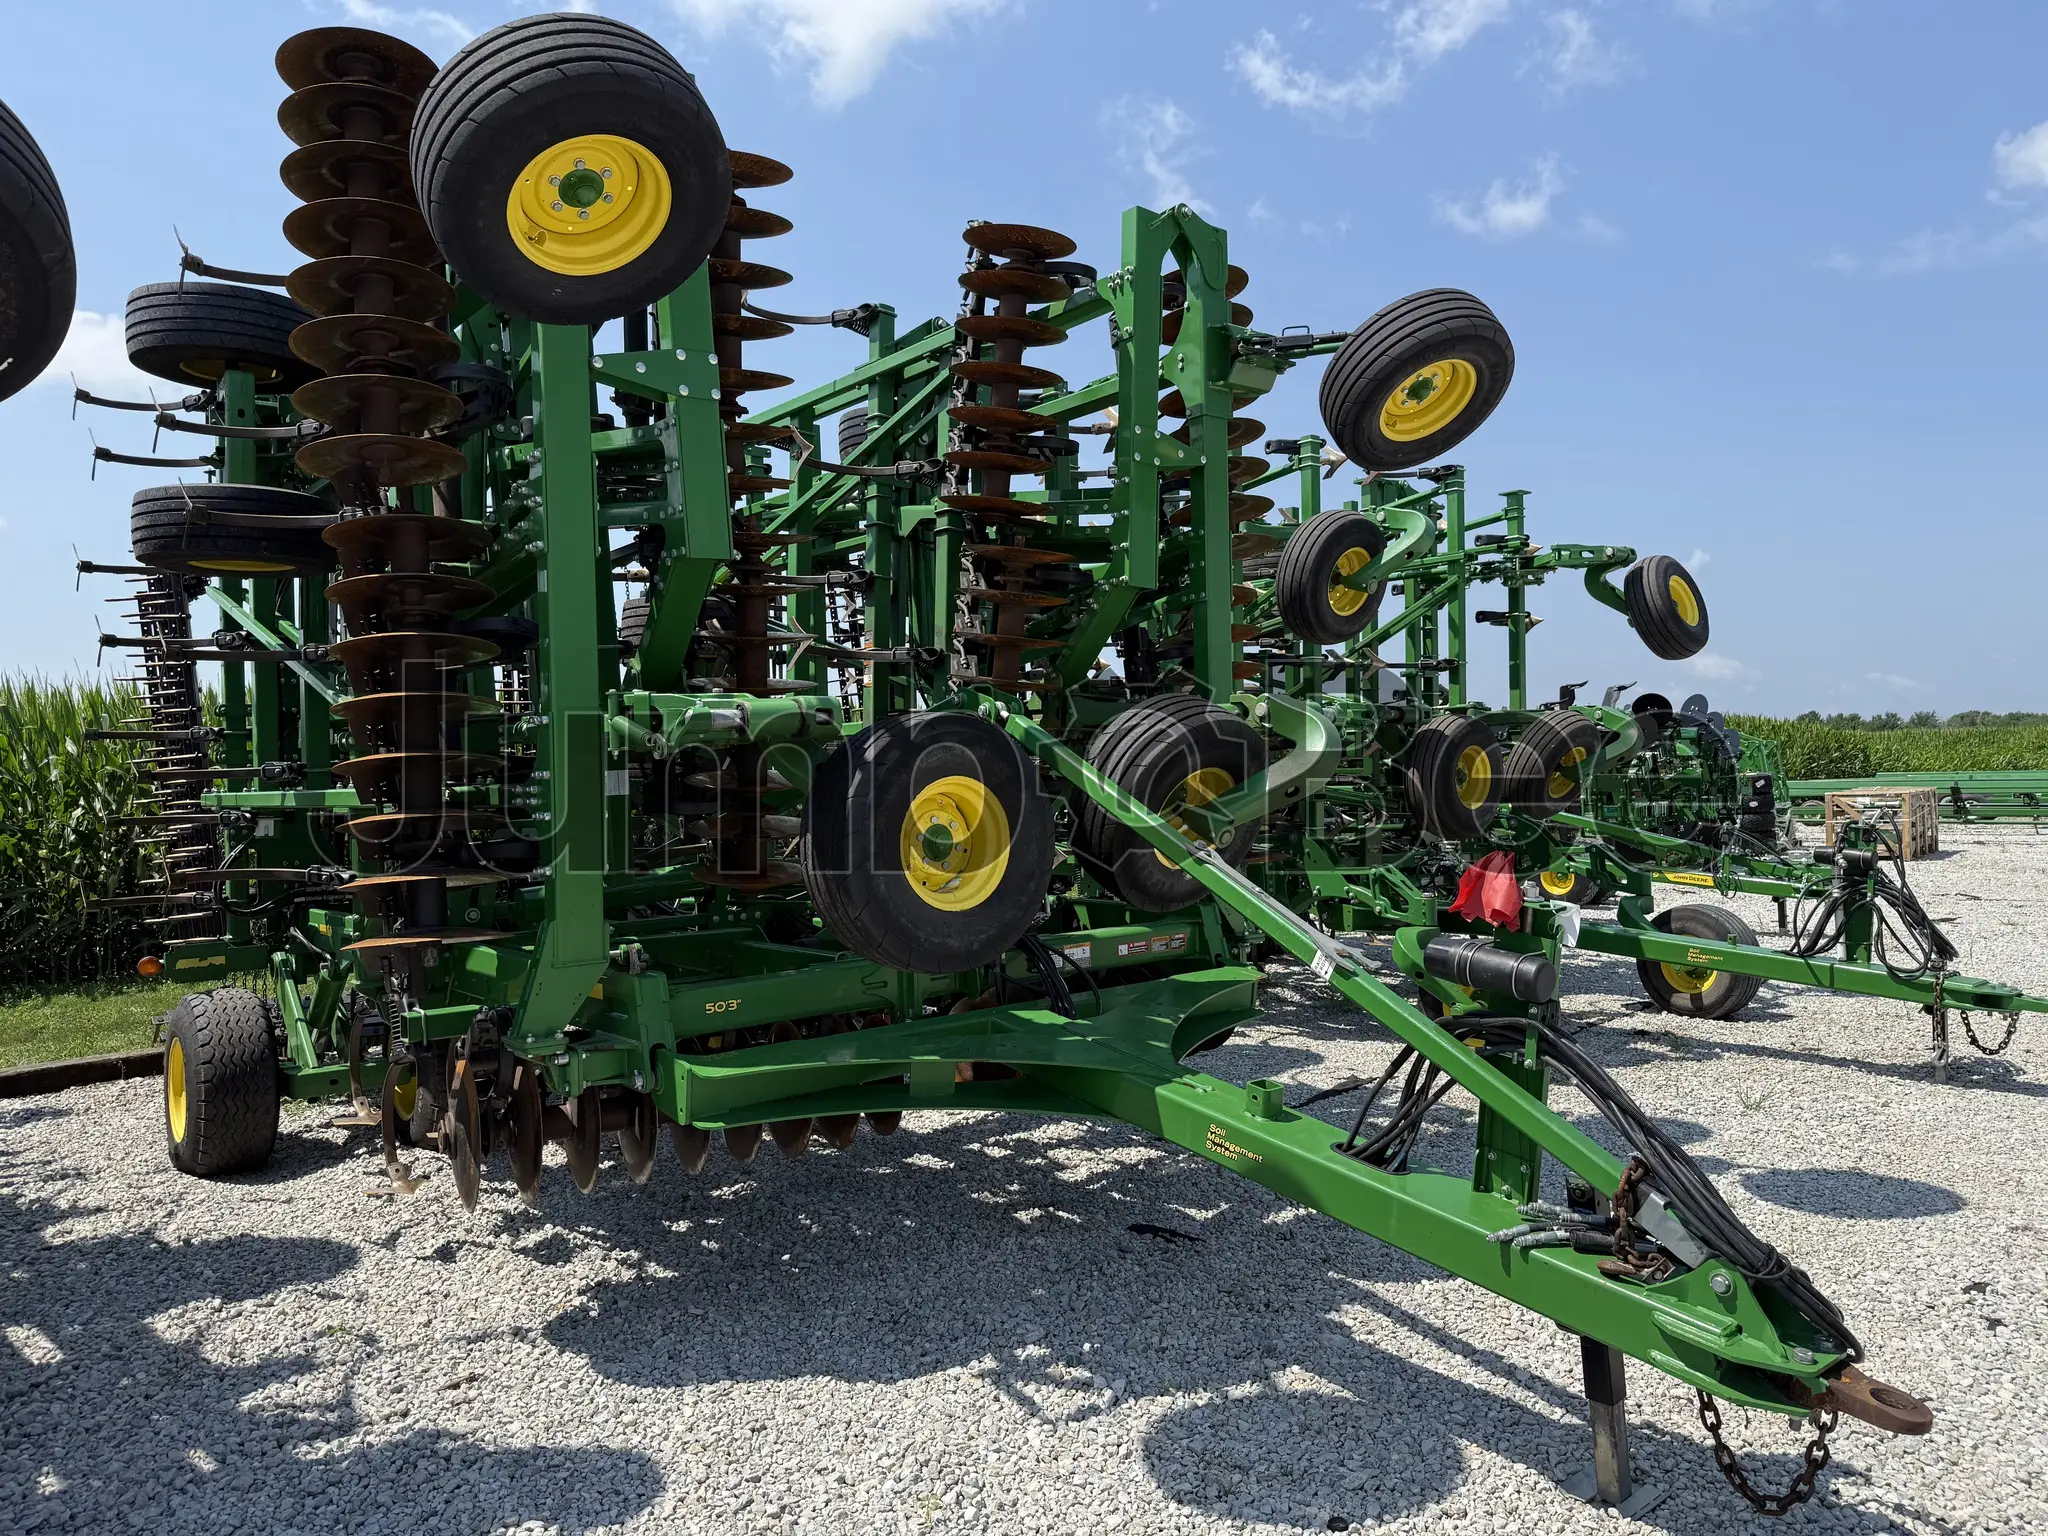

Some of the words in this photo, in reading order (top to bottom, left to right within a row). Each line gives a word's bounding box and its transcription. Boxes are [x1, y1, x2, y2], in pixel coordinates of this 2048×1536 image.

[1688, 875, 1709, 883] DEERE
[705, 999, 742, 1014] 50'3"
[1209, 1123, 1226, 1137] Soil
[1205, 1140, 1238, 1161] System
[1206, 1131, 1263, 1163] Management
